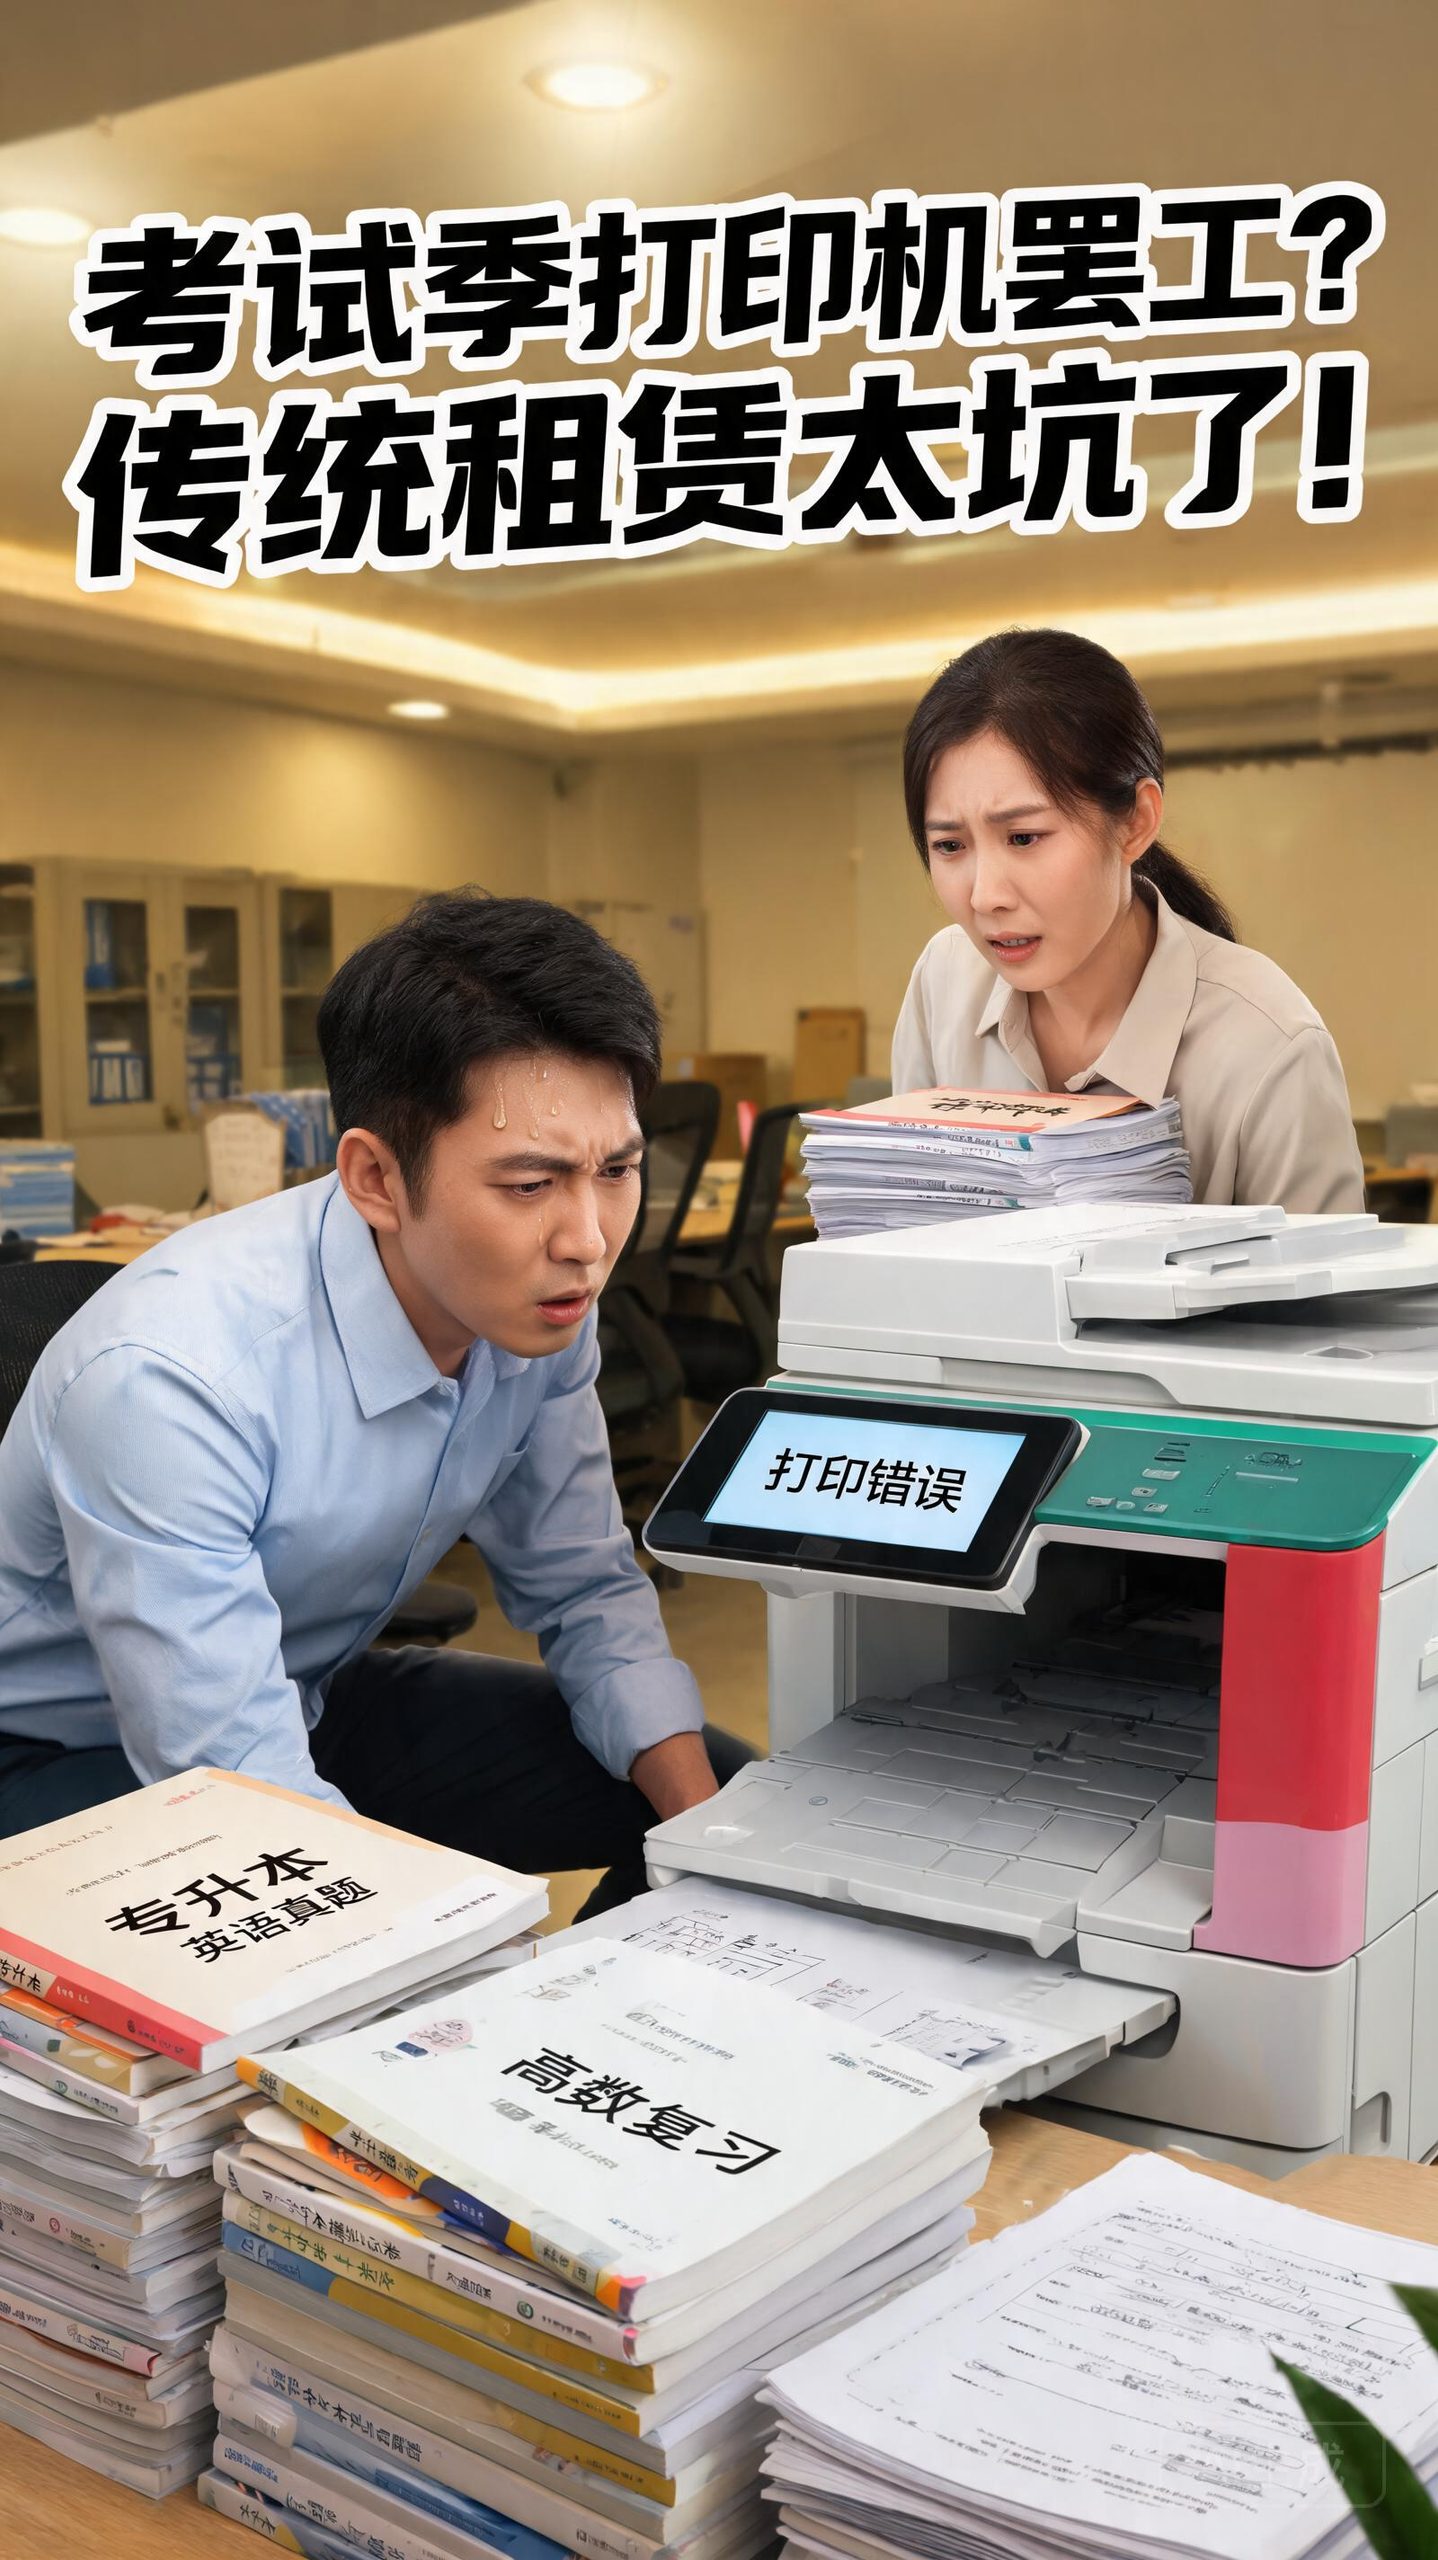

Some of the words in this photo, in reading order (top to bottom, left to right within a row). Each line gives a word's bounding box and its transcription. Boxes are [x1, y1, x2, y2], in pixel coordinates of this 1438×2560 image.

[764, 1447, 967, 1514] 打印错误
[104, 1847, 328, 1936] 专升本
[180, 1876, 379, 1963] 英语真题
[499, 2046, 782, 2175] 高数复习
